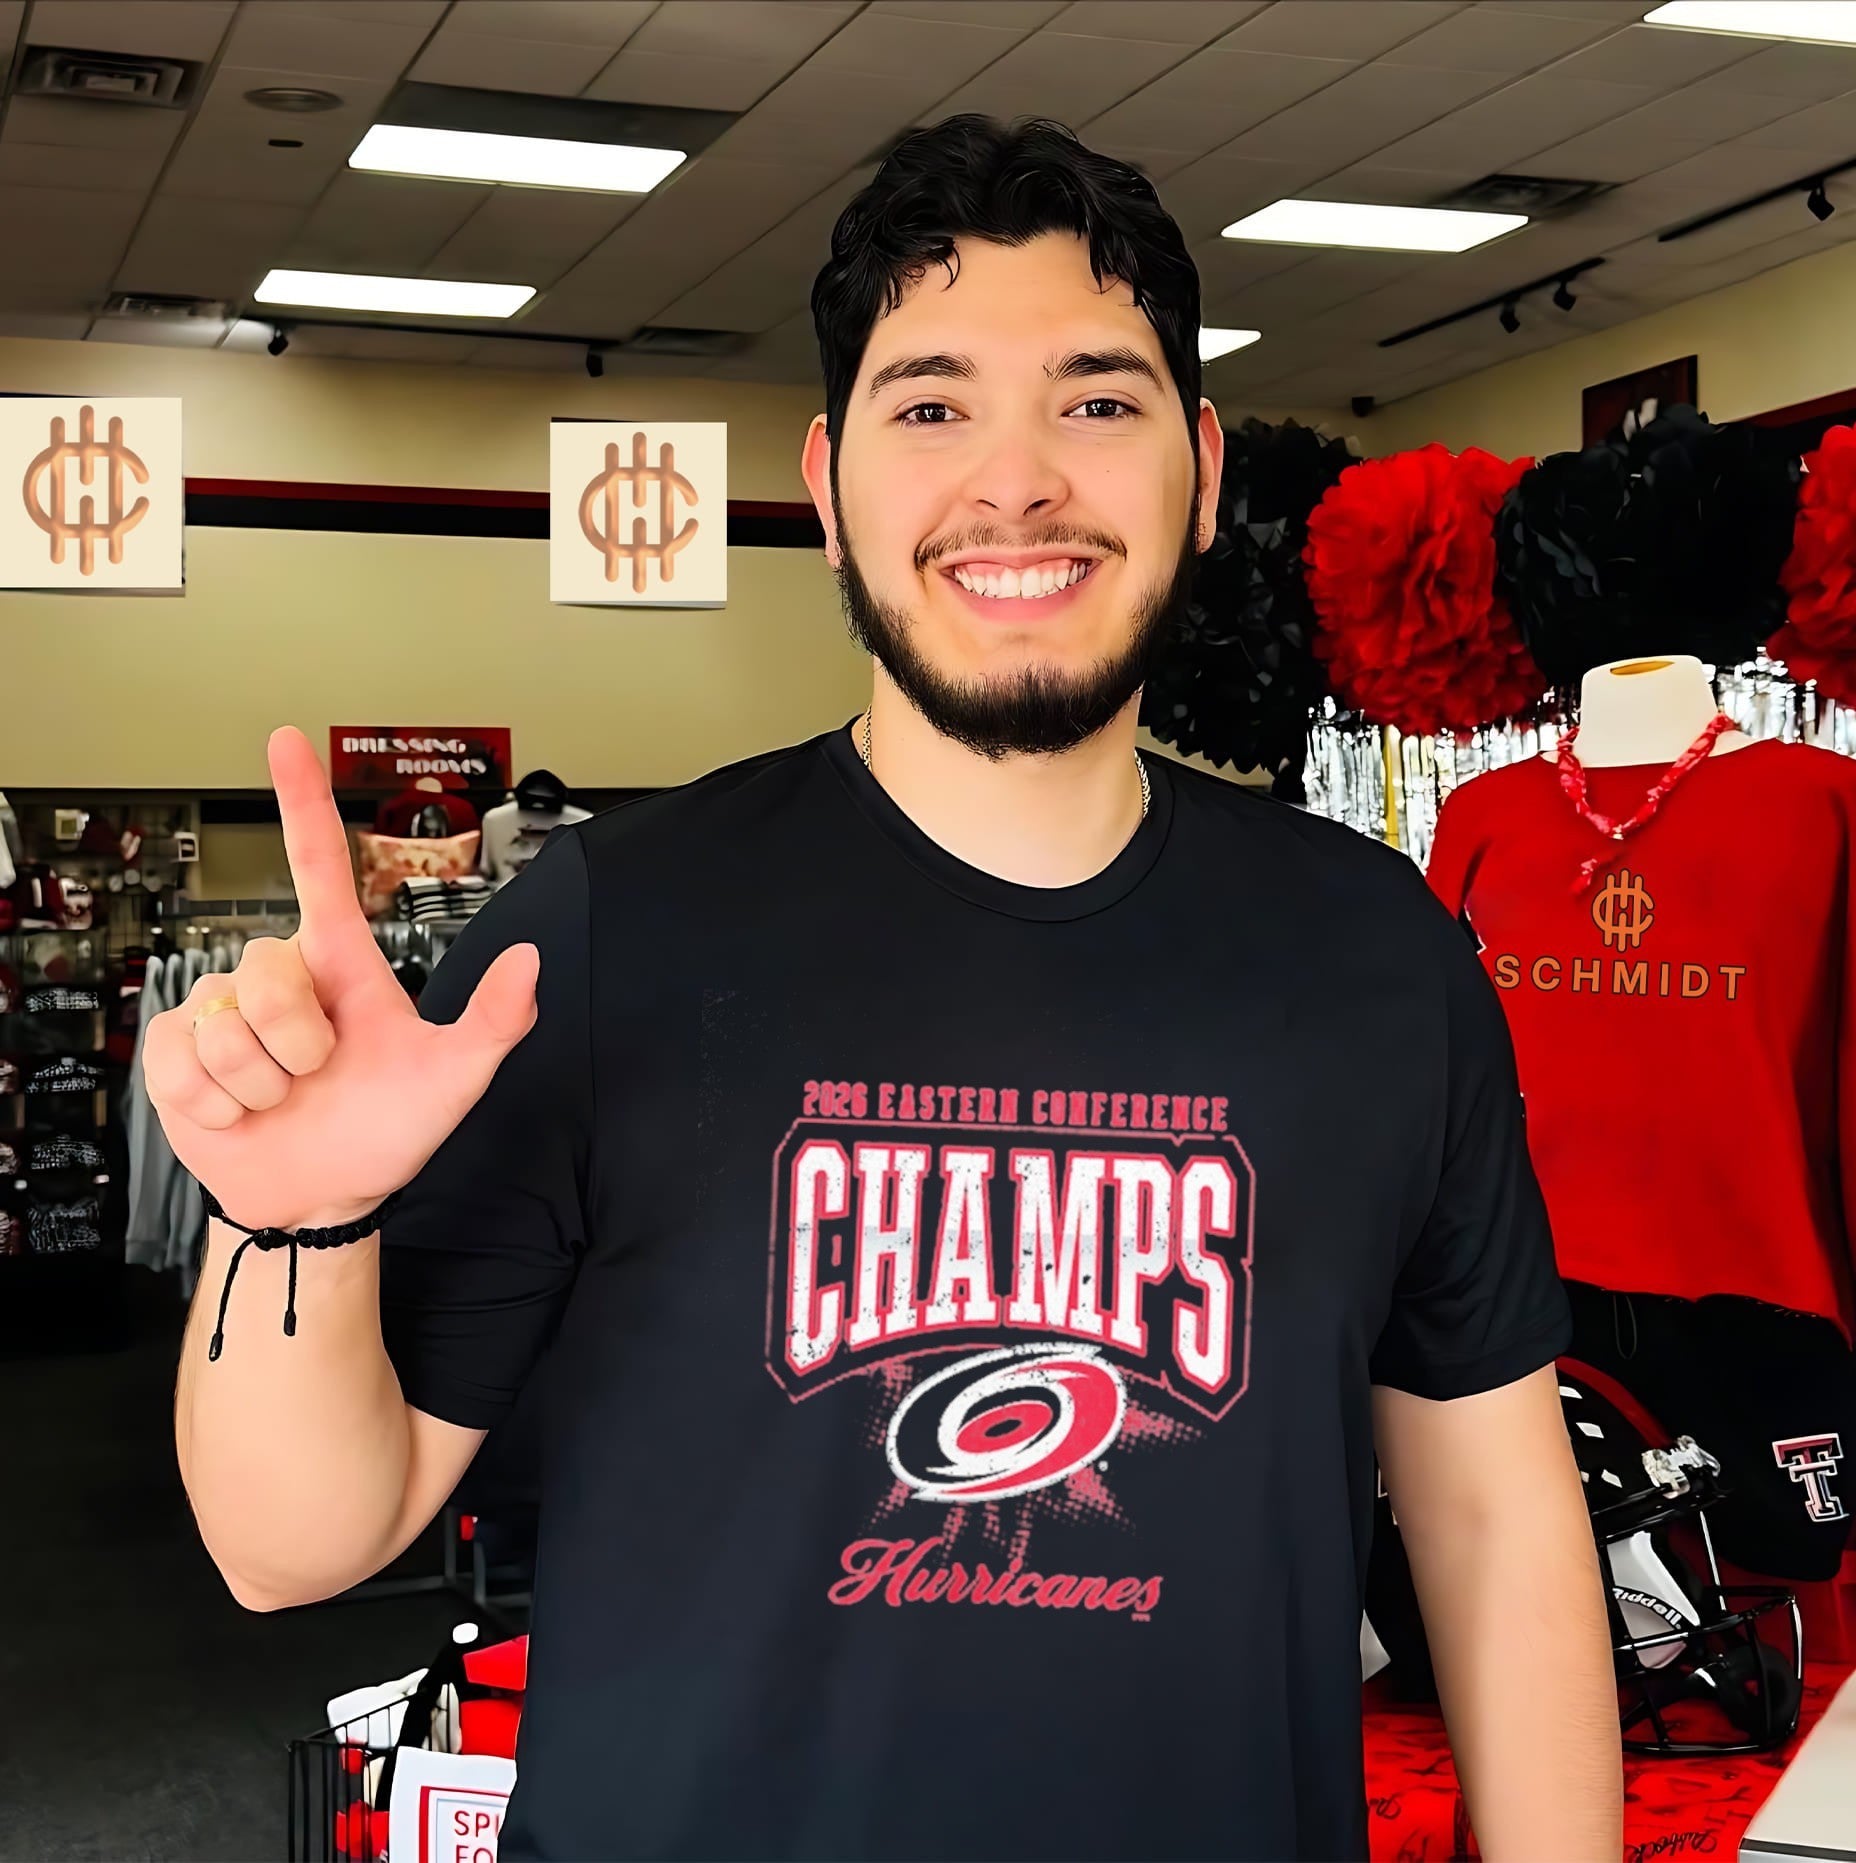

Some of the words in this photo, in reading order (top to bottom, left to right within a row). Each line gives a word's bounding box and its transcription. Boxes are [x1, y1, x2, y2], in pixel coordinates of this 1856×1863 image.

[342, 736, 467, 754] DRESSING
[396, 758, 487, 775] ROOMS
[1493, 953, 1748, 1001] SCHMIDT
[802, 1080, 868, 1118] 2026
[877, 1083, 1020, 1124] EASTERN
[1031, 1089, 1229, 1132] CONFERENCE
[785, 1138, 1238, 1396] CHAMPS
[827, 1537, 1164, 1612] Hurricanes
